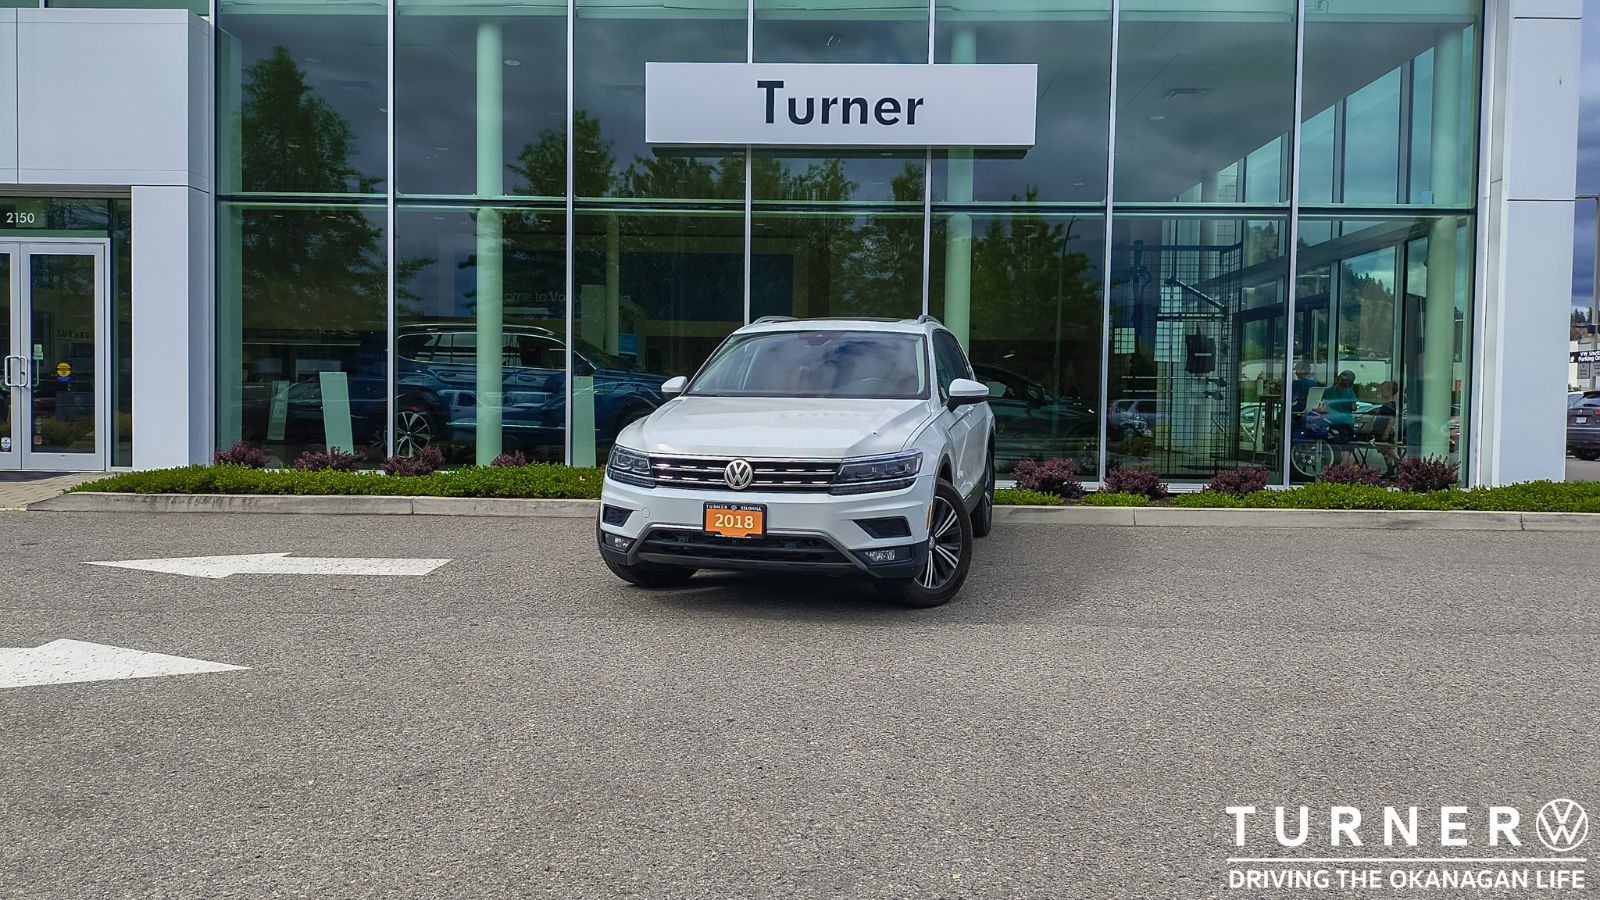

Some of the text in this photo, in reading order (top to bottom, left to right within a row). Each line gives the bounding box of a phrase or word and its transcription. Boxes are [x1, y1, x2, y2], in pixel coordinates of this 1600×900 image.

[757, 80, 924, 126] Turner
[6, 212, 35, 223] 2150
[714, 513, 754, 529] 2018
